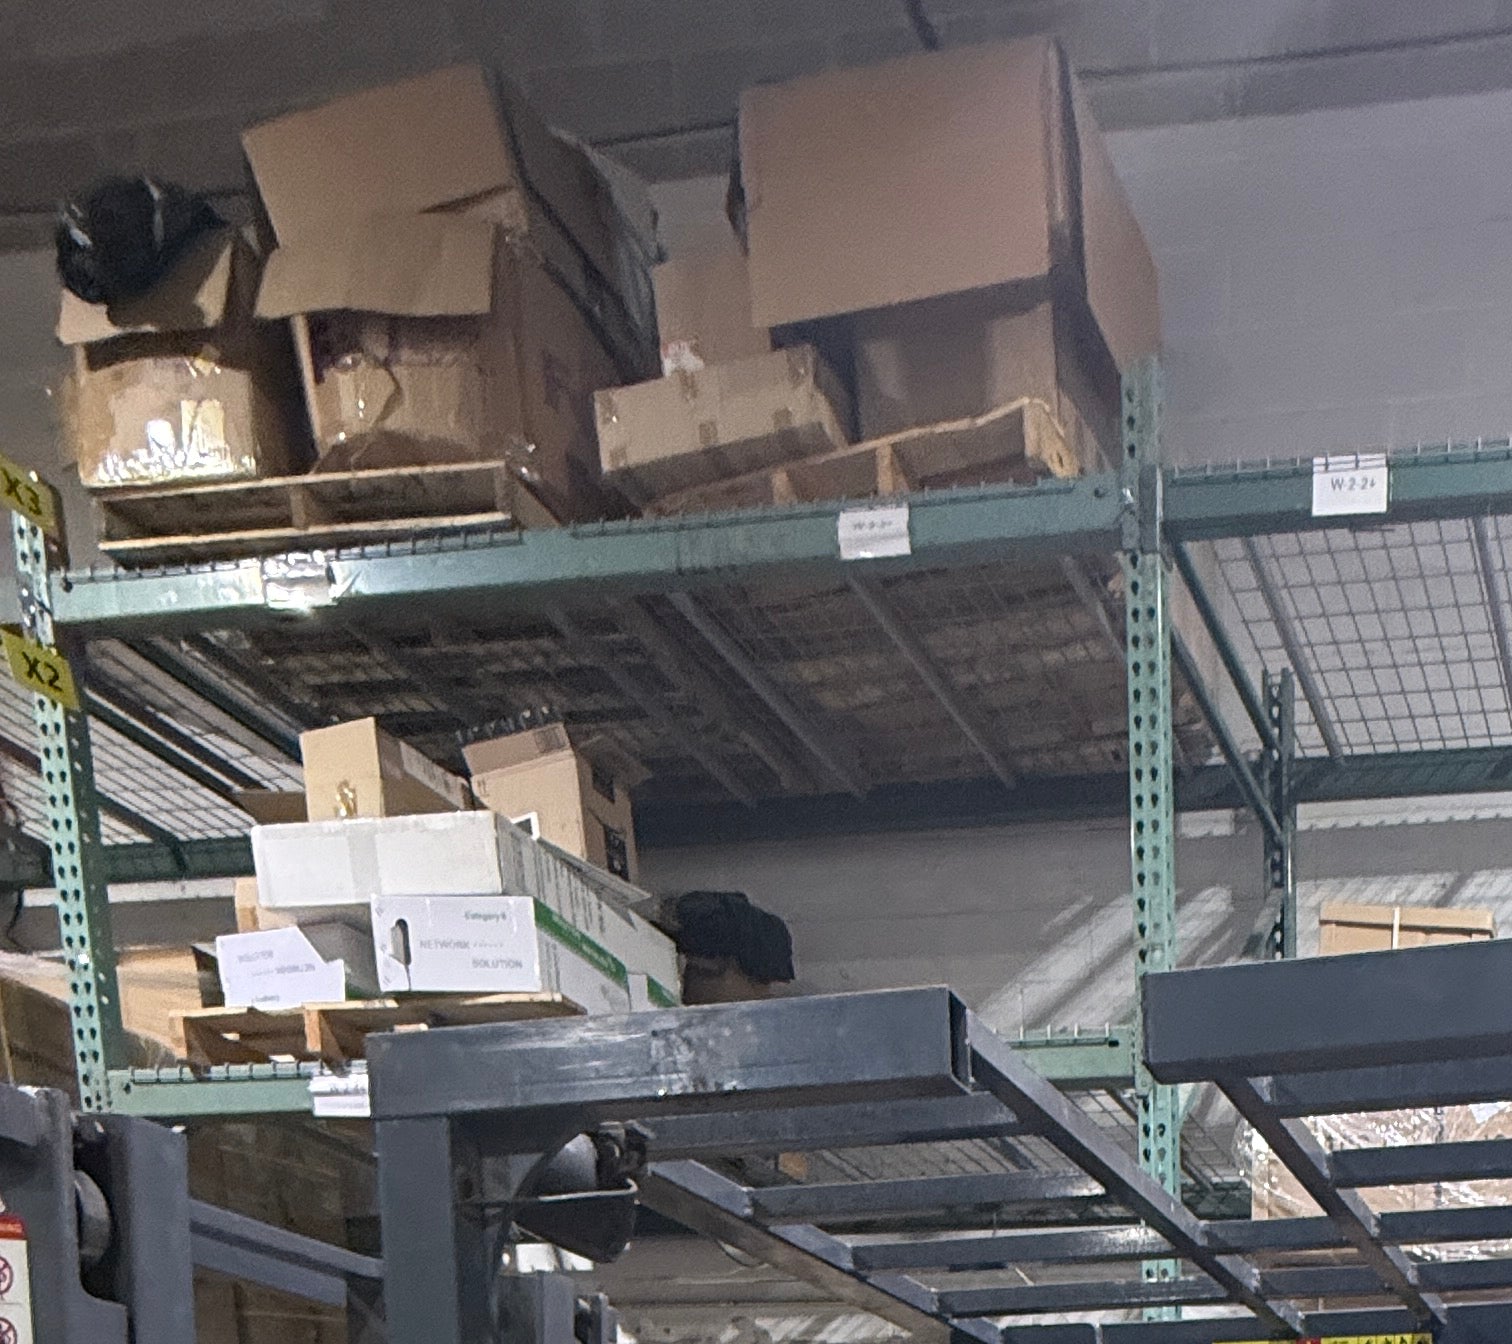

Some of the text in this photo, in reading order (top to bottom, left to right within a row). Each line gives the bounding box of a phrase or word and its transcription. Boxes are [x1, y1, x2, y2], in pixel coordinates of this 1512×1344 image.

[1, 467, 42, 516] X3
[22, 651, 64, 692] X2
[419, 939, 470, 950] NETWORK
[472, 958, 522, 970] SOLUTION
